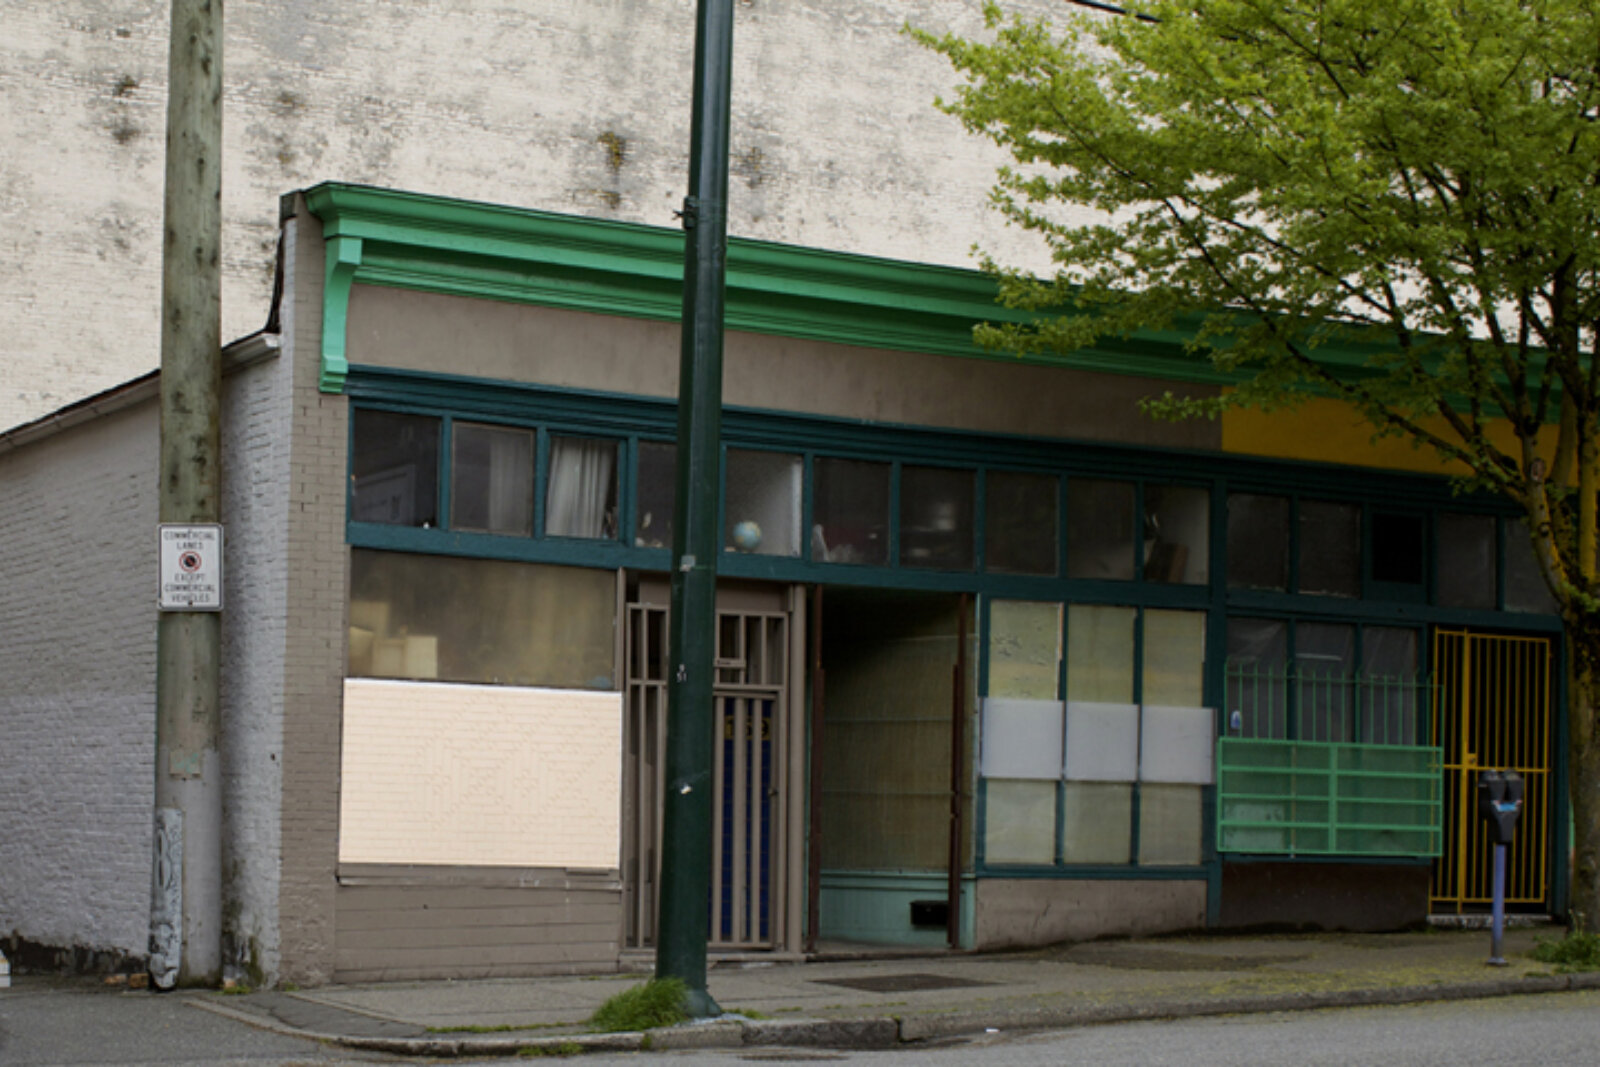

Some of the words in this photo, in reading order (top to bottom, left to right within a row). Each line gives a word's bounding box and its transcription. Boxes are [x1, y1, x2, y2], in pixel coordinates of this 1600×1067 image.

[174, 573, 206, 582] EXCEPT
[164, 584, 216, 593] COMMERCIAL
[171, 594, 210, 603] VEHICLES
